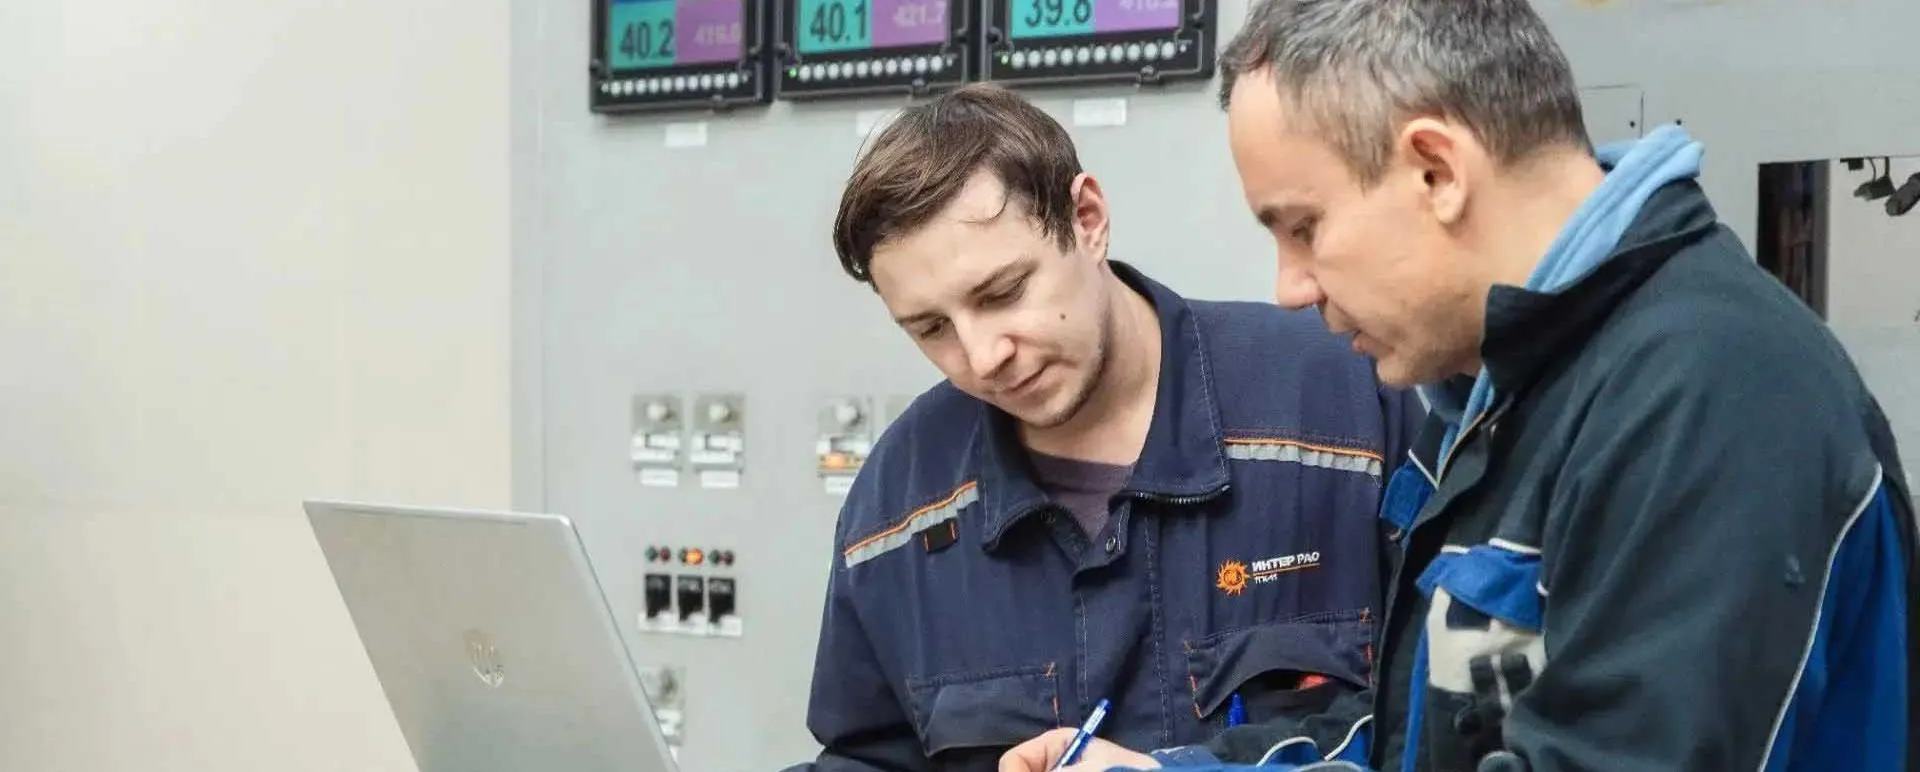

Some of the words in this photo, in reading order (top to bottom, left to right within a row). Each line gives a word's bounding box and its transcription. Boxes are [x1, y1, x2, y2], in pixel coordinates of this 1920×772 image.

[619, 19, 675, 61] 40.2
[809, 1, 866, 42] 40.1
[1252, 555, 1295, 571] ИНТЕР
[1297, 551, 1320, 565] РАО
